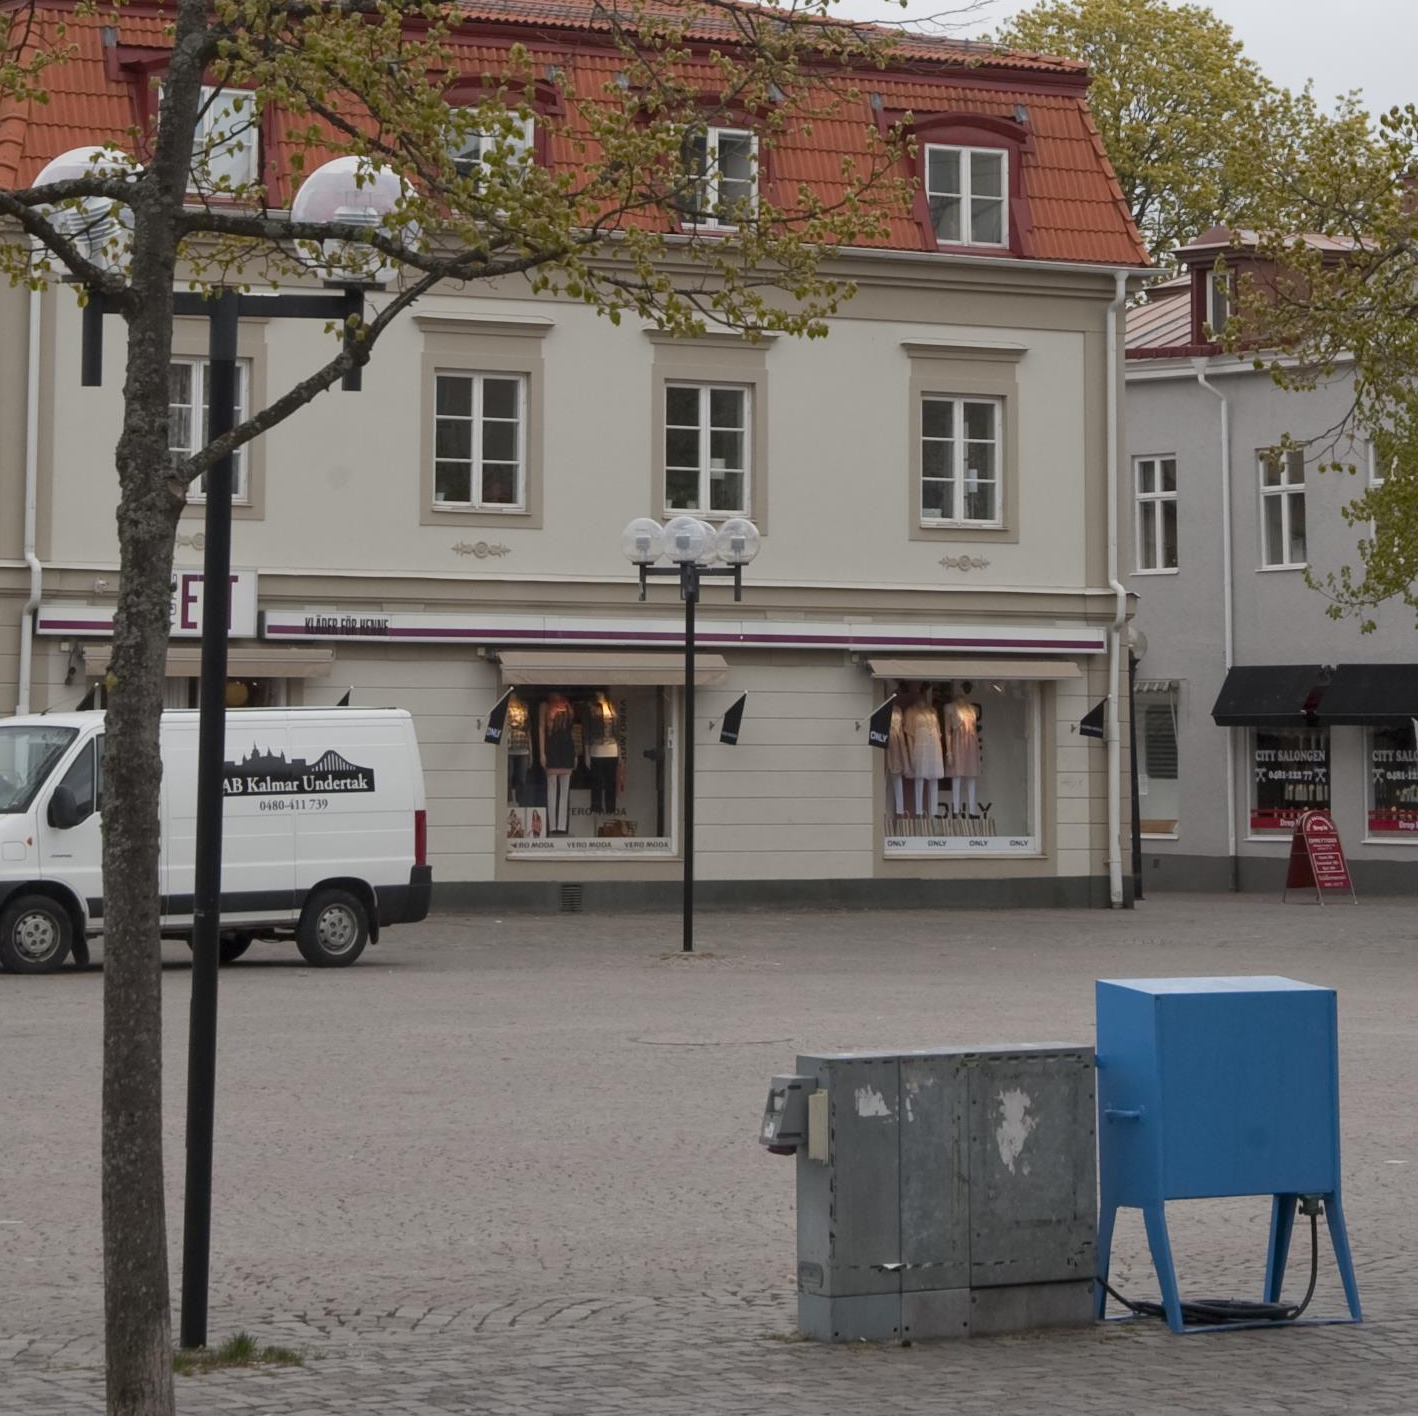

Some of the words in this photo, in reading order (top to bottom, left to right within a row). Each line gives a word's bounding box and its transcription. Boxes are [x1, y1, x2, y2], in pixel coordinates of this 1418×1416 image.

[305, 615, 335, 635] KLÄDER
[341, 615, 357, 636] FÖR
[360, 618, 389, 636] HENNE
[1255, 749, 1277, 762] CITY
[1278, 749, 1326, 762] SALONGEN
[1372, 750, 1395, 762] CITY
[222, 777, 244, 794] AB
[246, 775, 300, 792] Kalmar
[302, 773, 369, 791] Undertak
[259, 799, 306, 811] 0480-411
[309, 798, 329, 810] 739
